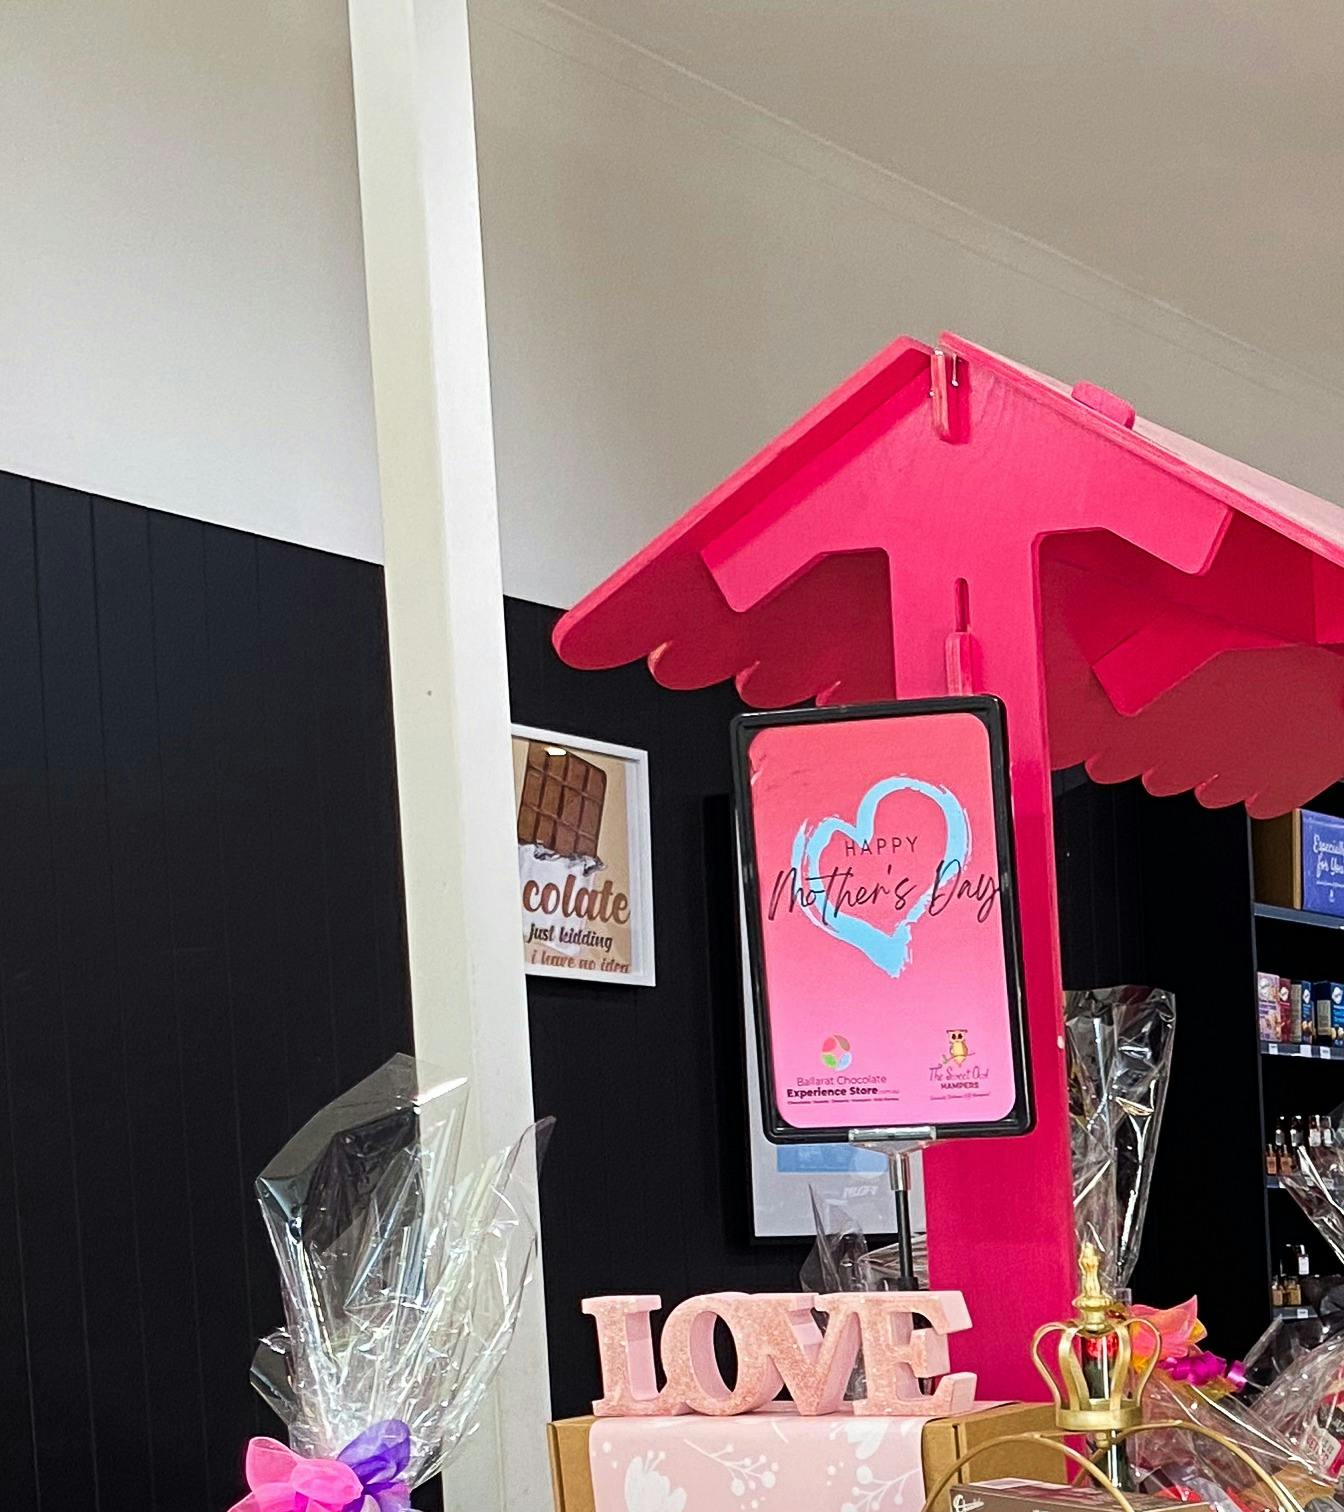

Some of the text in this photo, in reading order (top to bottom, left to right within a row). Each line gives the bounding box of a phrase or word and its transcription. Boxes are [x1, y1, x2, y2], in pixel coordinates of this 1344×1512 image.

[844, 834, 920, 858] HAPPY
[522, 873, 631, 926] colate
[767, 858, 1002, 924] Mother's Day
[558, 924, 614, 953] kidding
[786, 1087, 849, 1099] Experience
[581, 1290, 978, 1417] LOVE
